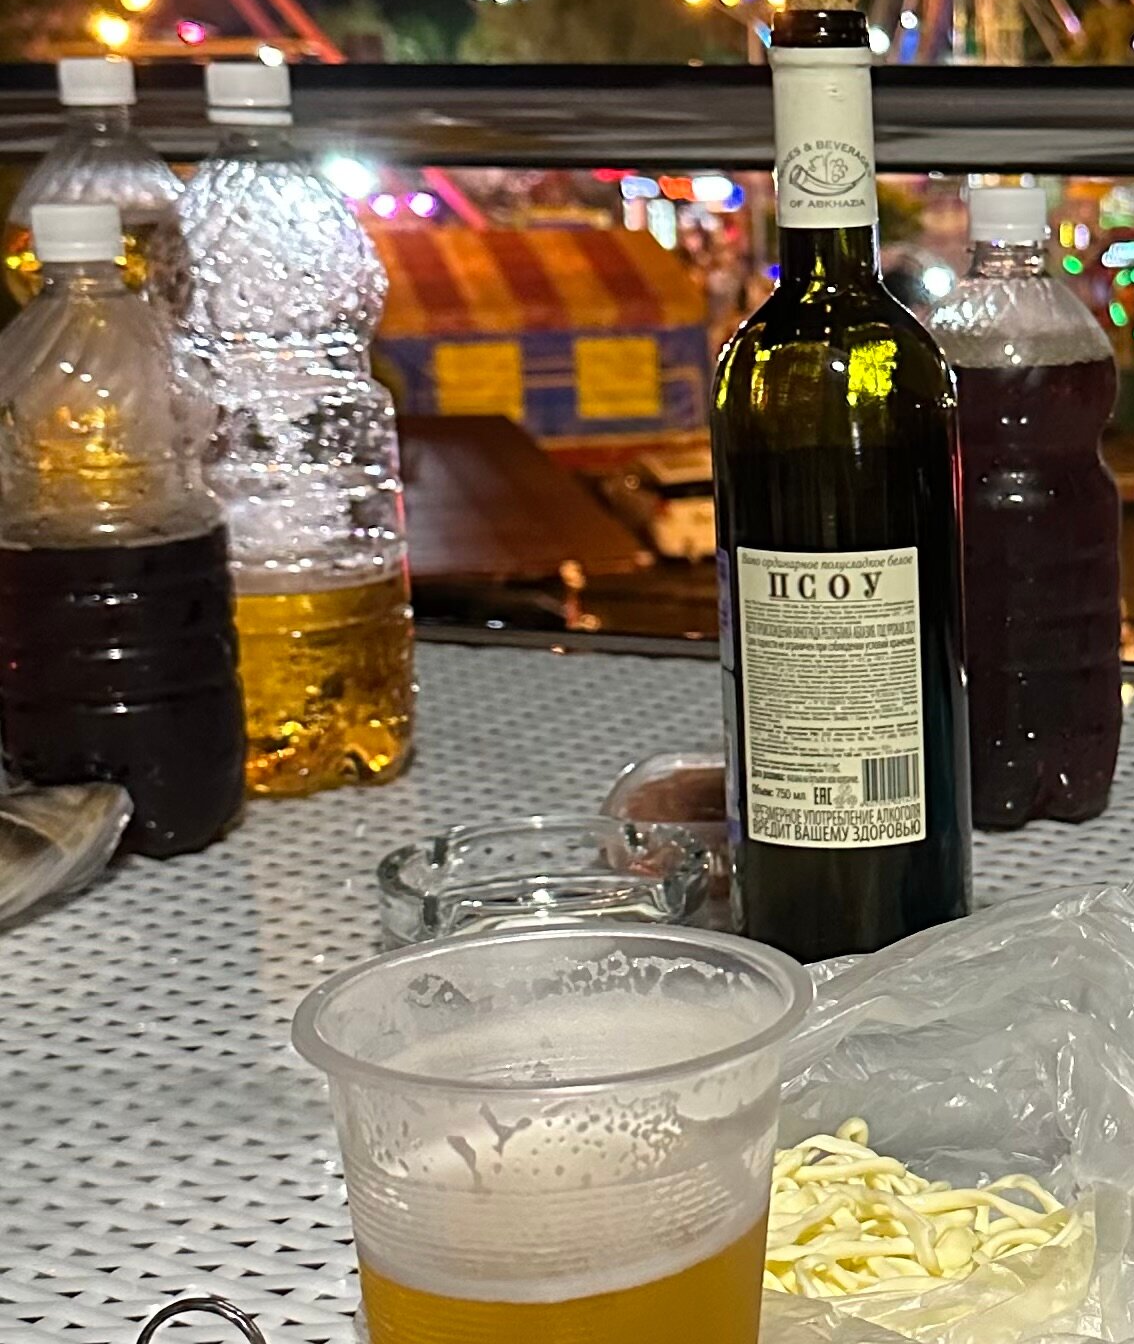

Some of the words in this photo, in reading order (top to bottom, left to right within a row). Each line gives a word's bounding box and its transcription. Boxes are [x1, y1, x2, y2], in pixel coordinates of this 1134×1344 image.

[803, 142, 812, 153] &
[789, 199, 804, 209] OF
[808, 199, 866, 209] ABKHAZIA
[821, 557, 886, 572] полусладкое
[887, 554, 913, 567] белое
[768, 570, 882, 600] ПСОУ
[775, 787, 791, 800] 750
[803, 808, 875, 826] УПОТРЕБЛЕНИЕ
[876, 802, 921, 824] АЛКОГОЛЯ
[752, 817, 793, 841] ВРЕДИТ
[795, 824, 850, 843] ВАШЕМУ
[851, 818, 921, 843] ЗДОРОВЬЮ
